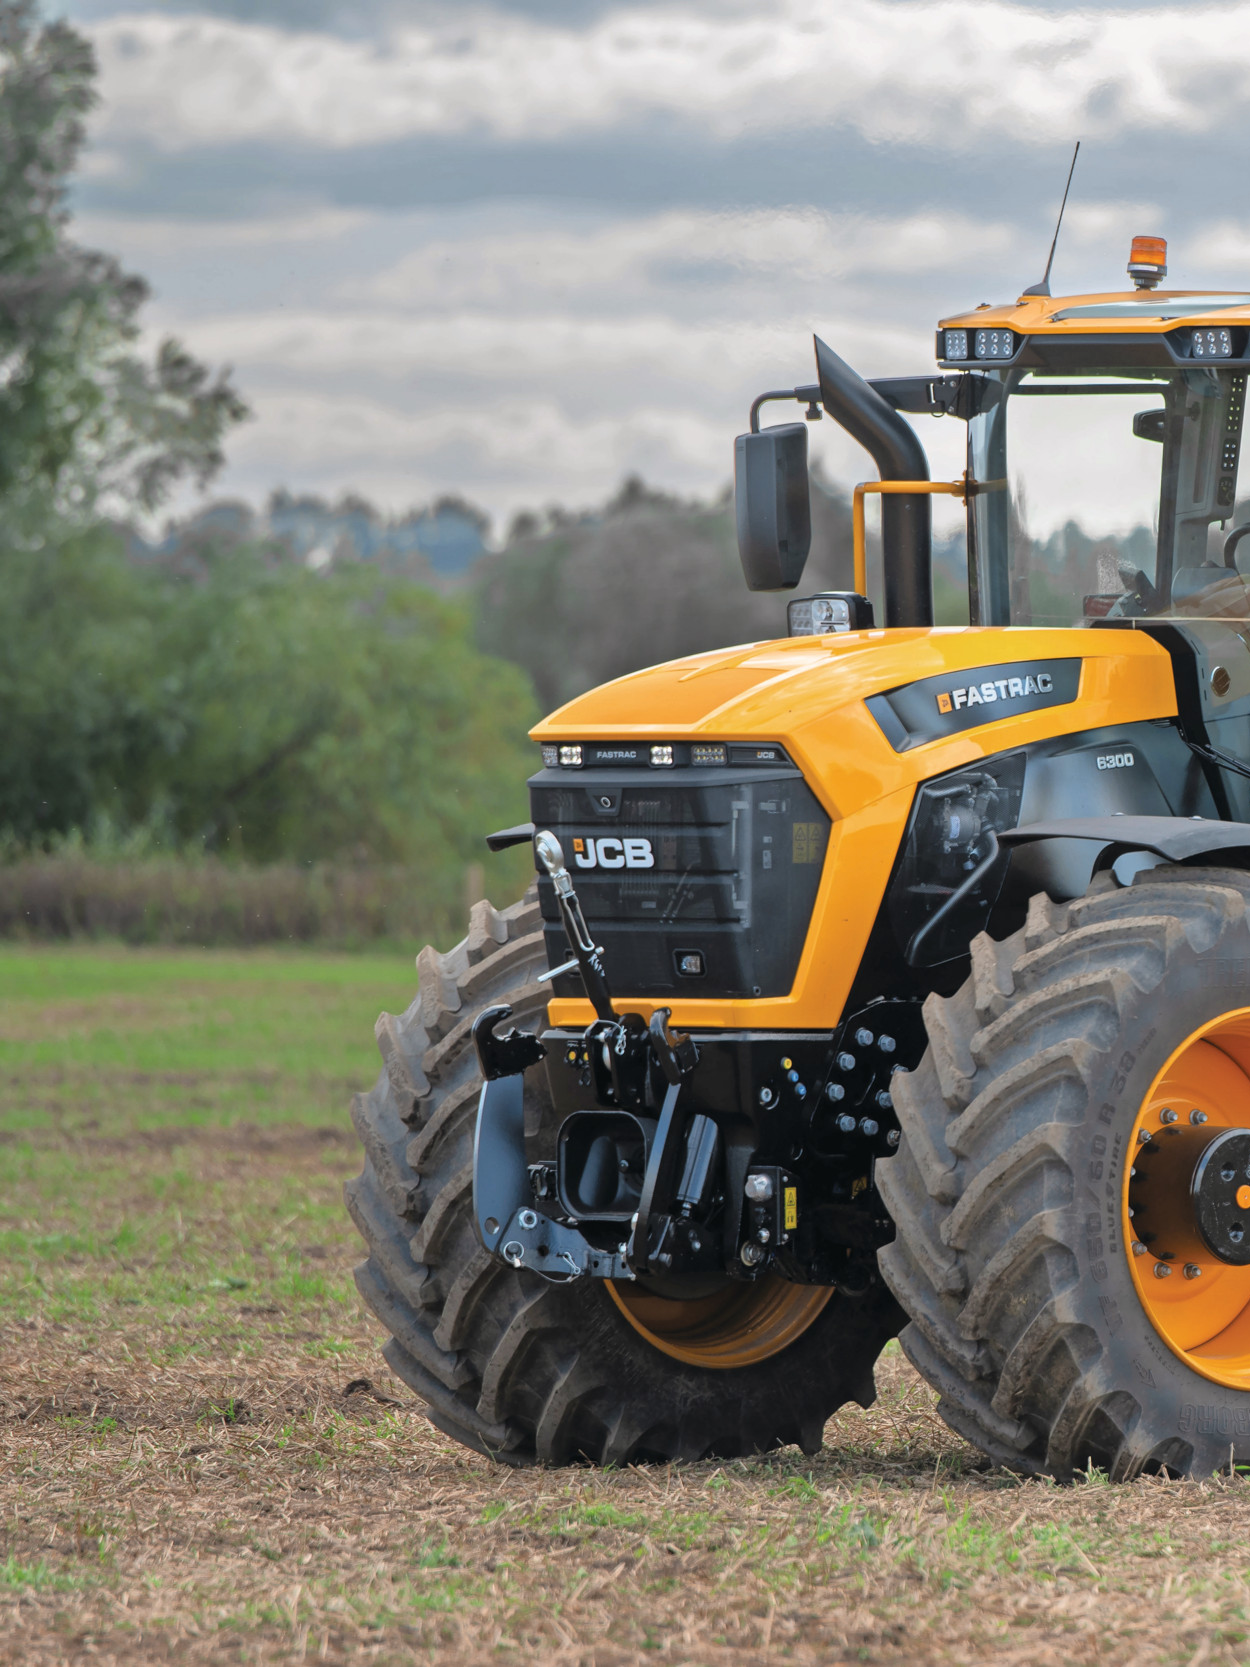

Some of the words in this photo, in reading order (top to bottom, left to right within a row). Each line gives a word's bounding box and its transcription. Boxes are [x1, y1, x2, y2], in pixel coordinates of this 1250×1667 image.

[951, 673, 1054, 711] FASTRAC
[596, 750, 637, 759] FASTRAC
[756, 751, 775, 759] JCB
[1096, 753, 1135, 771] 6300
[574, 838, 655, 869] JCB
